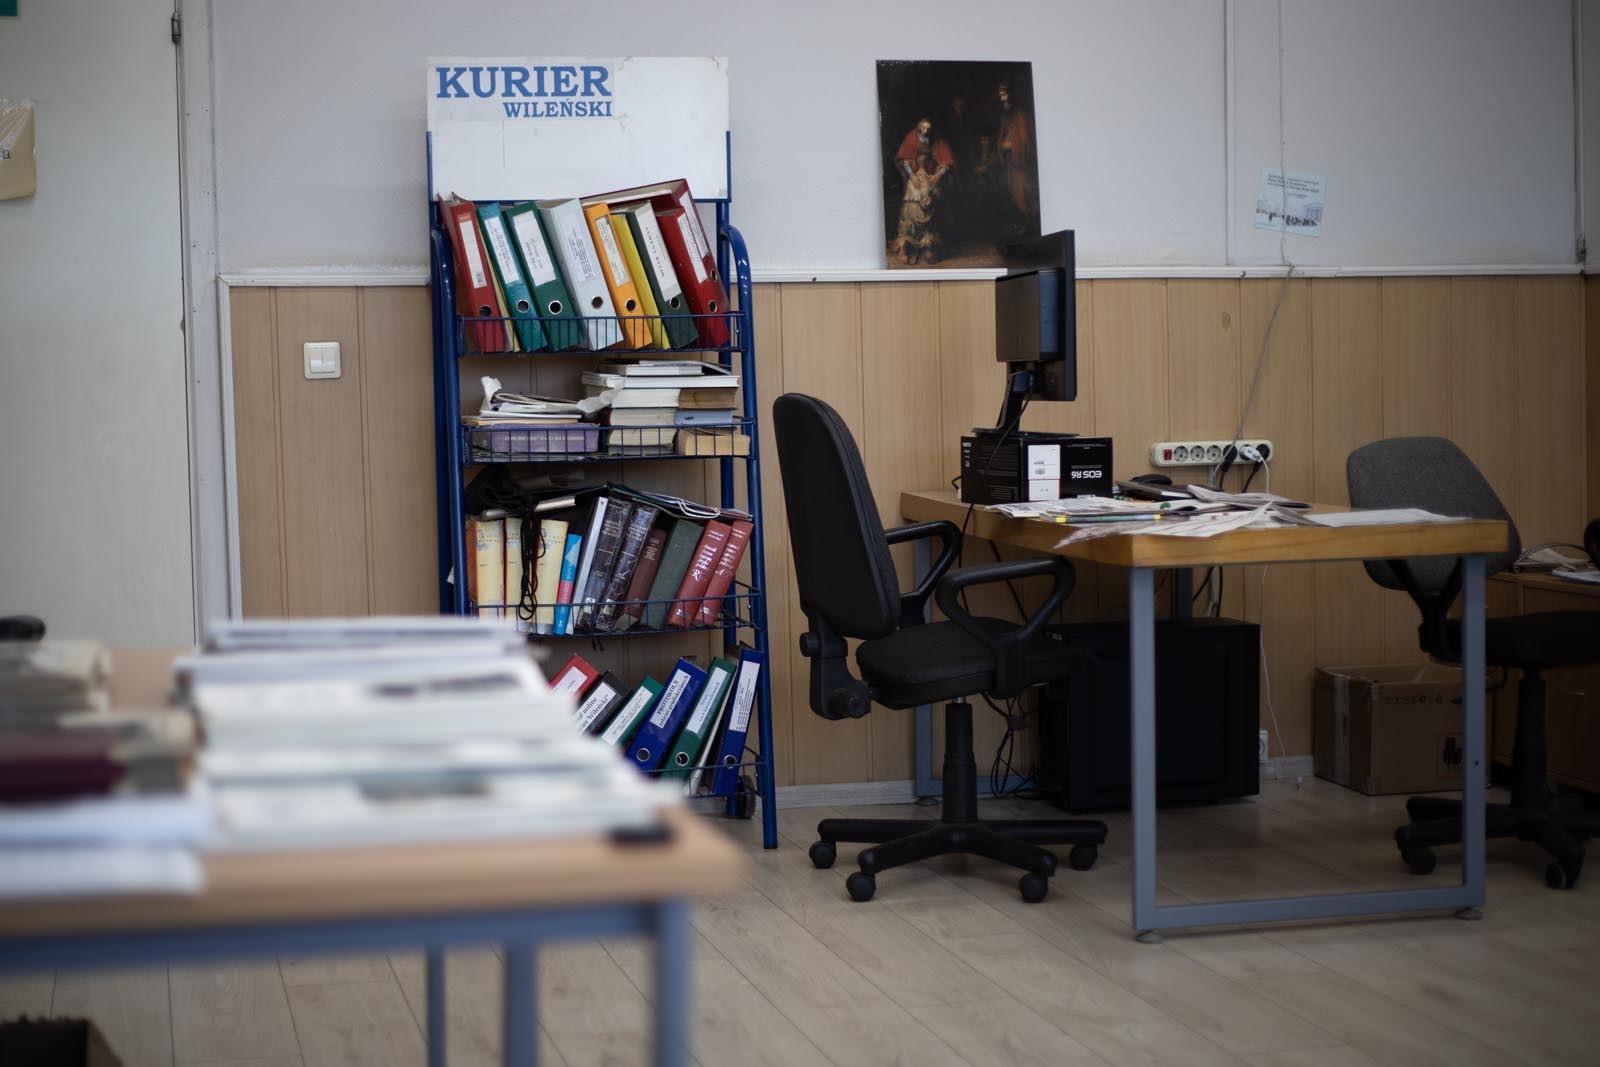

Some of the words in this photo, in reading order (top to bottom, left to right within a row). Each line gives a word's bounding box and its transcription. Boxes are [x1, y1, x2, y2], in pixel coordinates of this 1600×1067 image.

[436, 66, 612, 98] KURIER
[502, 98, 612, 118] WILEŃSKI
[1071, 470, 1082, 479] R6
[1082, 470, 1103, 479] EOS
[583, 697, 598, 714] online
